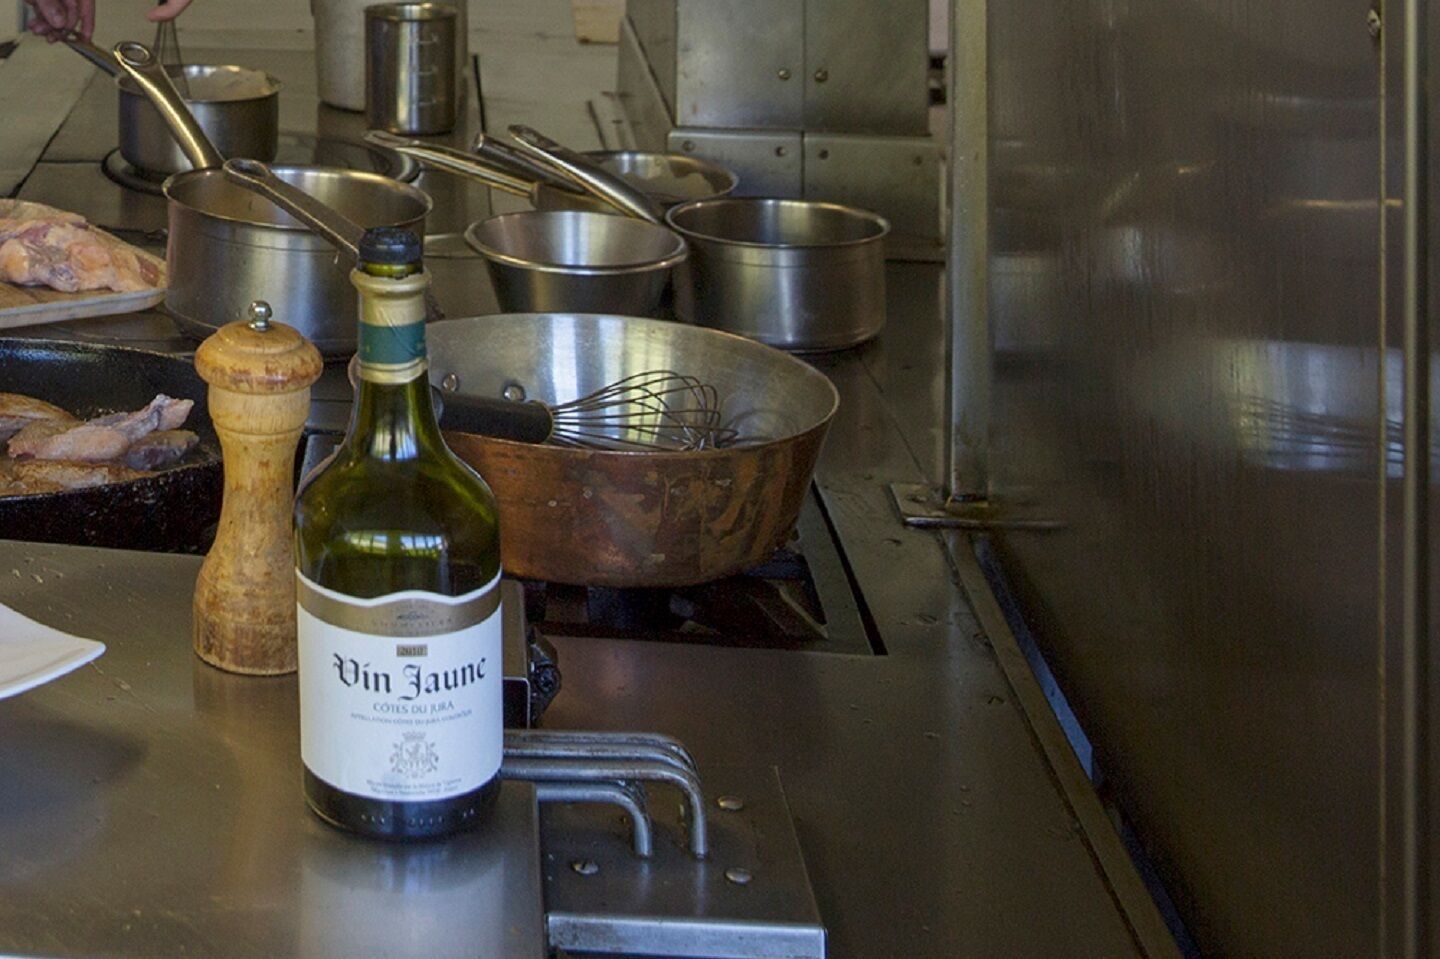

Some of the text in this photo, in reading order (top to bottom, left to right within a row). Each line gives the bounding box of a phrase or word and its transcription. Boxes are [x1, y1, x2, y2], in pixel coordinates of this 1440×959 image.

[333, 652, 487, 701] Vin Jaune
[411, 704, 428, 715] DU
[430, 700, 455, 714] JURA
